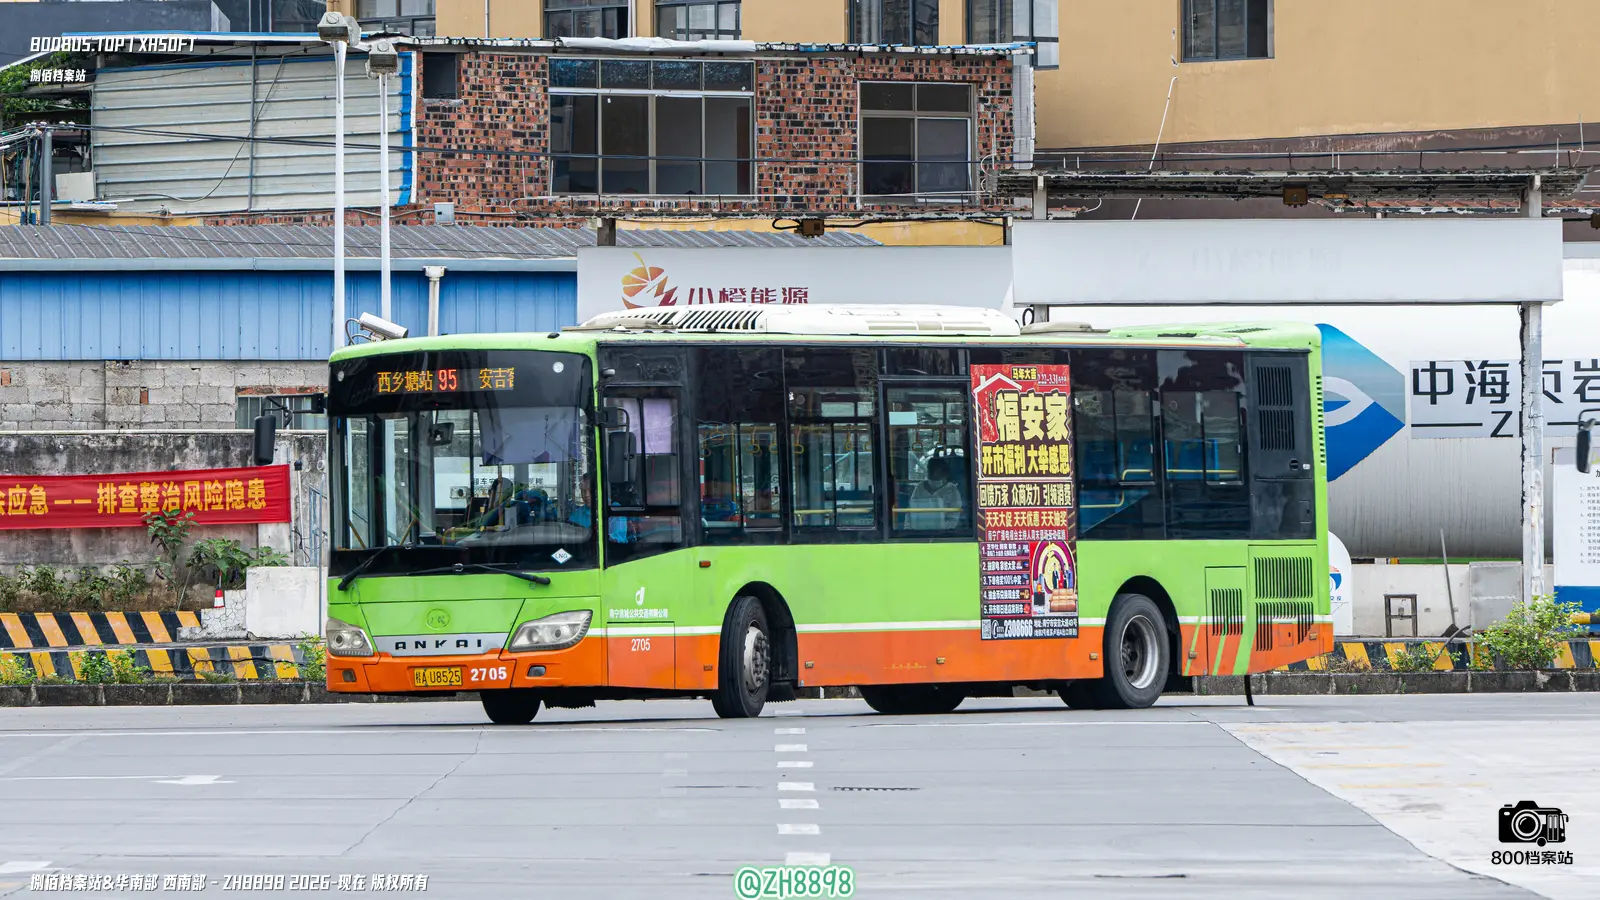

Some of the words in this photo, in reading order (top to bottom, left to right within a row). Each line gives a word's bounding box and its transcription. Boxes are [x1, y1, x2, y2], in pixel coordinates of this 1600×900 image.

[688, 287, 808, 304] 小橙能源
[377, 370, 433, 393] 西乡塘站
[438, 369, 457, 391] 95
[1012, 367, 1037, 380] 马年大吉
[996, 390, 1069, 441] 福安家
[982, 444, 1025, 475] 开市福利
[1027, 444, 1071, 475] 大举感恩
[97, 478, 267, 514] 排查整治风险隐患
[980, 484, 1009, 507] 回馈万家
[1011, 484, 1040, 506] 众商发力
[1042, 484, 1072, 506] 引领消费
[986, 511, 1012, 528] 天天大促
[1014, 511, 1039, 527] 天天优惠
[1041, 511, 1067, 527] 天天抽奖
[395, 639, 482, 651] ANKAI
[631, 638, 651, 651] 2705
[470, 666, 508, 682] 2705
